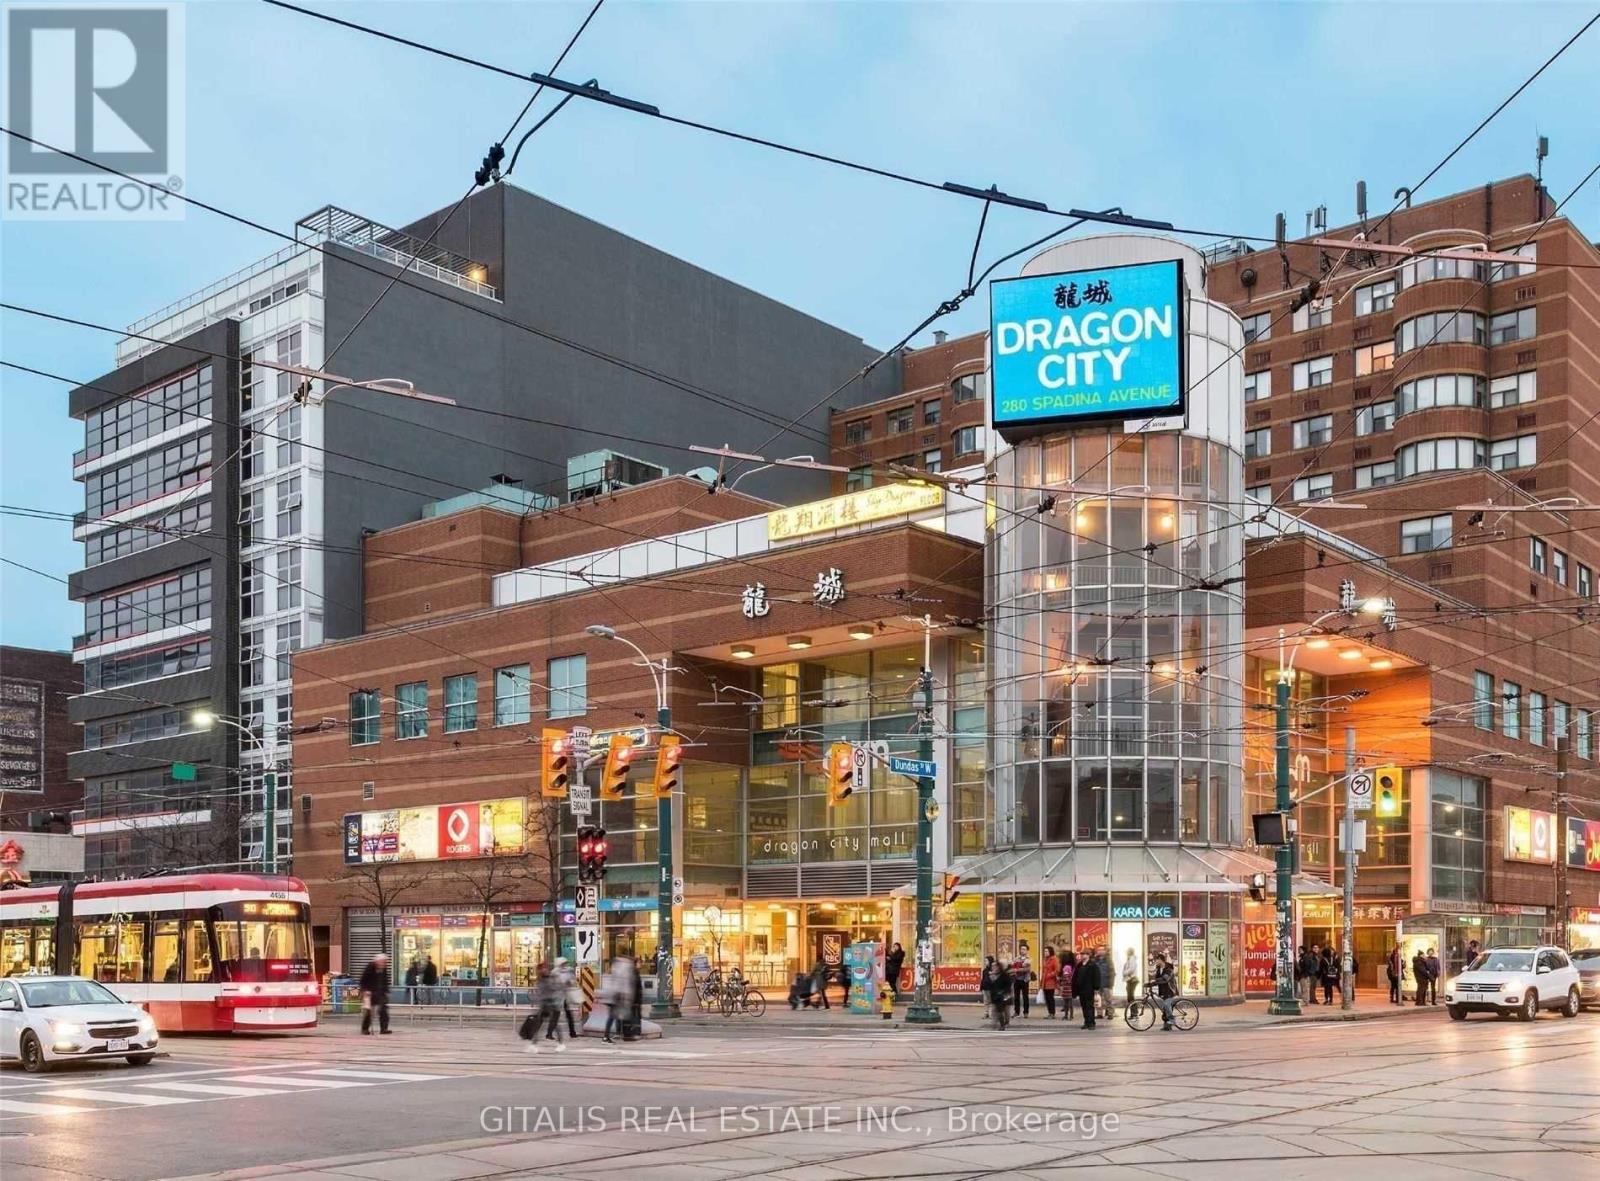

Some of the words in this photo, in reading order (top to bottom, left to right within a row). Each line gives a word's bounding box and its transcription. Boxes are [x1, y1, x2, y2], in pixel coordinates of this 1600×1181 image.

[1054, 280, 1113, 309] 龍城
[997, 305, 1172, 355] DRAGON
[1037, 346, 1132, 389] CITY
[1002, 399, 1028, 413] 280
[1031, 391, 1102, 411] SPADINA
[1108, 384, 1171, 403] AVENUE
[742, 582, 770, 618] 龍
[812, 567, 845, 604] 城
[895, 759, 919, 772] Dundas
[924, 763, 932, 773] W
[571, 788, 590, 800] TRANSIT
[572, 801, 589, 811] SIGNAL
[446, 843, 472, 854] ROGERS
[763, 840, 818, 855] dragon
[830, 836, 860, 852] city
[870, 831, 906, 847] mall
[825, 954, 840, 963] RBC
[1245, 950, 1278, 961] umplin
[939, 979, 981, 991] dumpling
